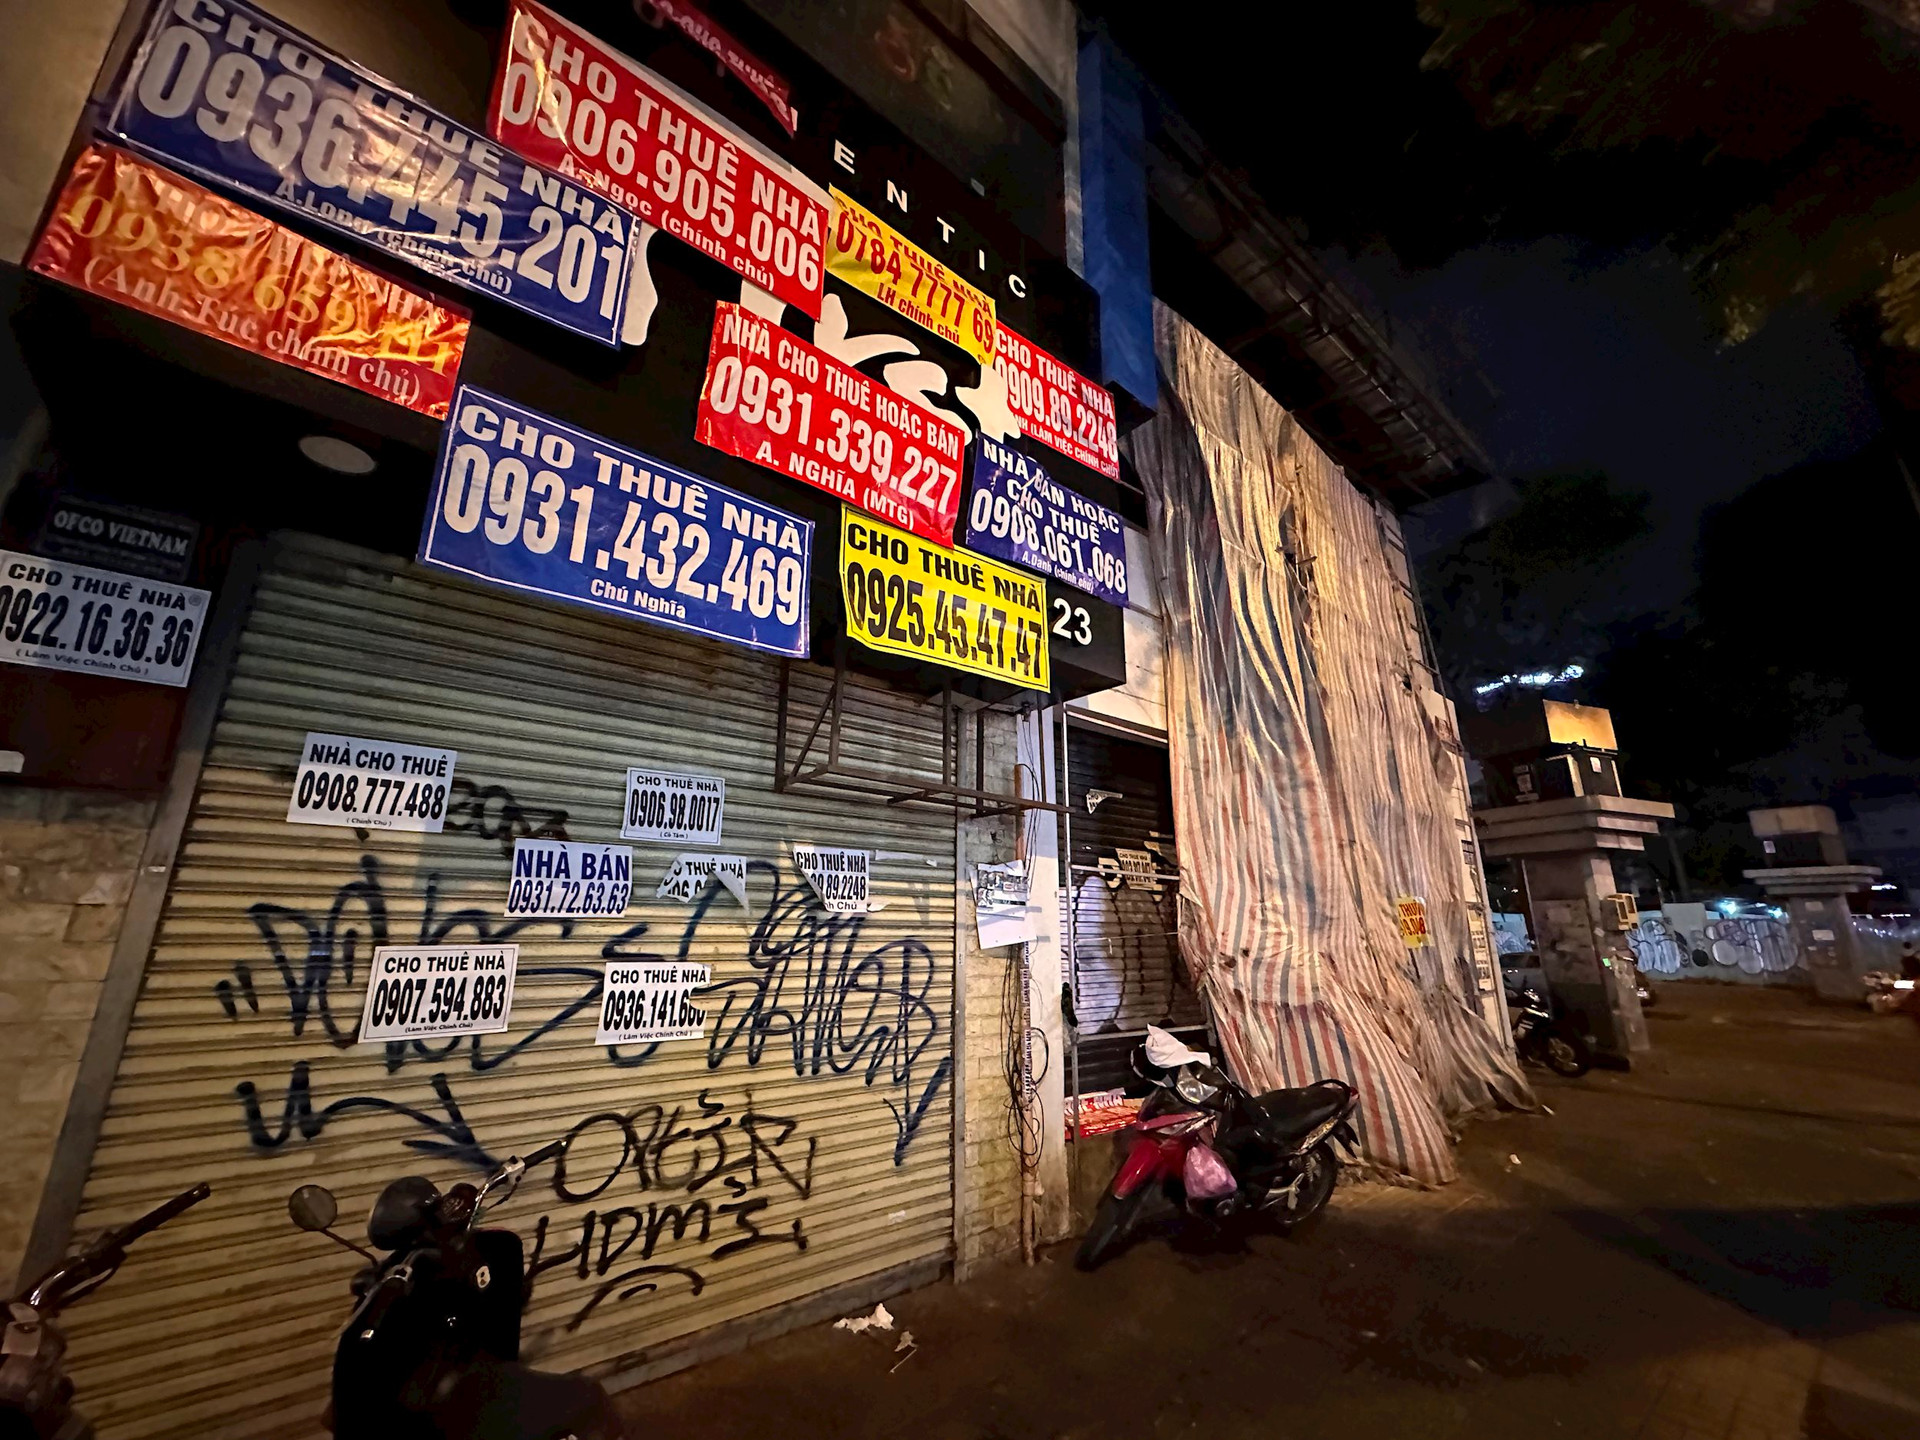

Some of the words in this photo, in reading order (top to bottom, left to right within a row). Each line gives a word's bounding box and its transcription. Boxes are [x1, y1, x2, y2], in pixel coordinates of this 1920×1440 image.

[513, 14, 617, 104] CHO
[634, 89, 740, 191] THUÊ
[751, 169, 821, 247] NHÀ
[502, 62, 820, 292] 0906.905.006
[520, 165, 624, 245] NHÀ
[68, 194, 240, 290] 0938
[661, 209, 727, 261] (chính
[733, 255, 775, 292] chủ)
[889, 234, 946, 282] THUÊ
[836, 210, 902, 286] 0784
[910, 262, 966, 328] 7777
[972, 306, 994, 354] 69
[876, 282, 896, 307] LH
[898, 297, 934, 331] chính
[936, 322, 960, 345] chủ
[359, 358, 421, 407] chủ)
[722, 312, 771, 360] NHÀ
[777, 338, 819, 384] CHO
[825, 363, 871, 413] THUÊ
[876, 393, 922, 440] HOẶC
[927, 423, 959, 462] BÁN
[994, 328, 1032, 369] CHO
[1035, 353, 1078, 399] THUÊ
[1080, 382, 1114, 420] NHÀ
[709, 356, 957, 516] 0931.339.227
[1054, 435, 1073, 455] VIỆC
[459, 404, 576, 470] CHO
[592, 449, 708, 522] THUÊ
[721, 503, 803, 556] NHÀ
[788, 451, 856, 500] NGHĨA
[863, 486, 914, 531] (MTG)
[983, 438, 1029, 482] NHÀ
[1070, 495, 1120, 534] HOẶC
[109, 520, 189, 556] VIETNAM
[443, 443, 802, 627] 0931.432.469
[970, 488, 1127, 594] 0908.061.068
[1006, 478, 1043, 519] CHO
[1048, 506, 1100, 546] THUÊ
[8, 562, 63, 587] CHO
[72, 574, 133, 600] THUÊ
[139, 588, 186, 611] NHÀ
[590, 578, 629, 604] Chú
[633, 589, 687, 620] Nghĩa
[847, 522, 909, 566] CHO
[918, 547, 986, 592] THUÊ
[992, 574, 1041, 613] NHÀ
[847, 561, 1042, 679] 0925.45.47.47
[1051, 597, 1093, 646] 23
[309, 741, 350, 766] NHÀ
[355, 749, 395, 771] CHO
[401, 754, 448, 777] THUÊ
[636, 775, 661, 786] CHO
[664, 778, 693, 790] THUÊ
[696, 781, 719, 792] NHÀ
[297, 770, 446, 820] 0908.777.488
[629, 788, 720, 832] 0906.98.0017
[515, 843, 571, 879] NHÀ
[581, 847, 630, 882] BÁN
[795, 851, 818, 871] CHO
[819, 851, 845, 872] THUÊ
[847, 851, 866, 873] NHÀ
[508, 879, 629, 915] 0931.72.63.63
[384, 956, 421, 974] CHO
[427, 951, 470, 972] THUÊ
[473, 950, 506, 970] NHÀ
[610, 969, 639, 984] CHO
[643, 965, 678, 983] THUÊ
[681, 965, 706, 983] NHÀ
[372, 974, 507, 1027] 0907.594.883
